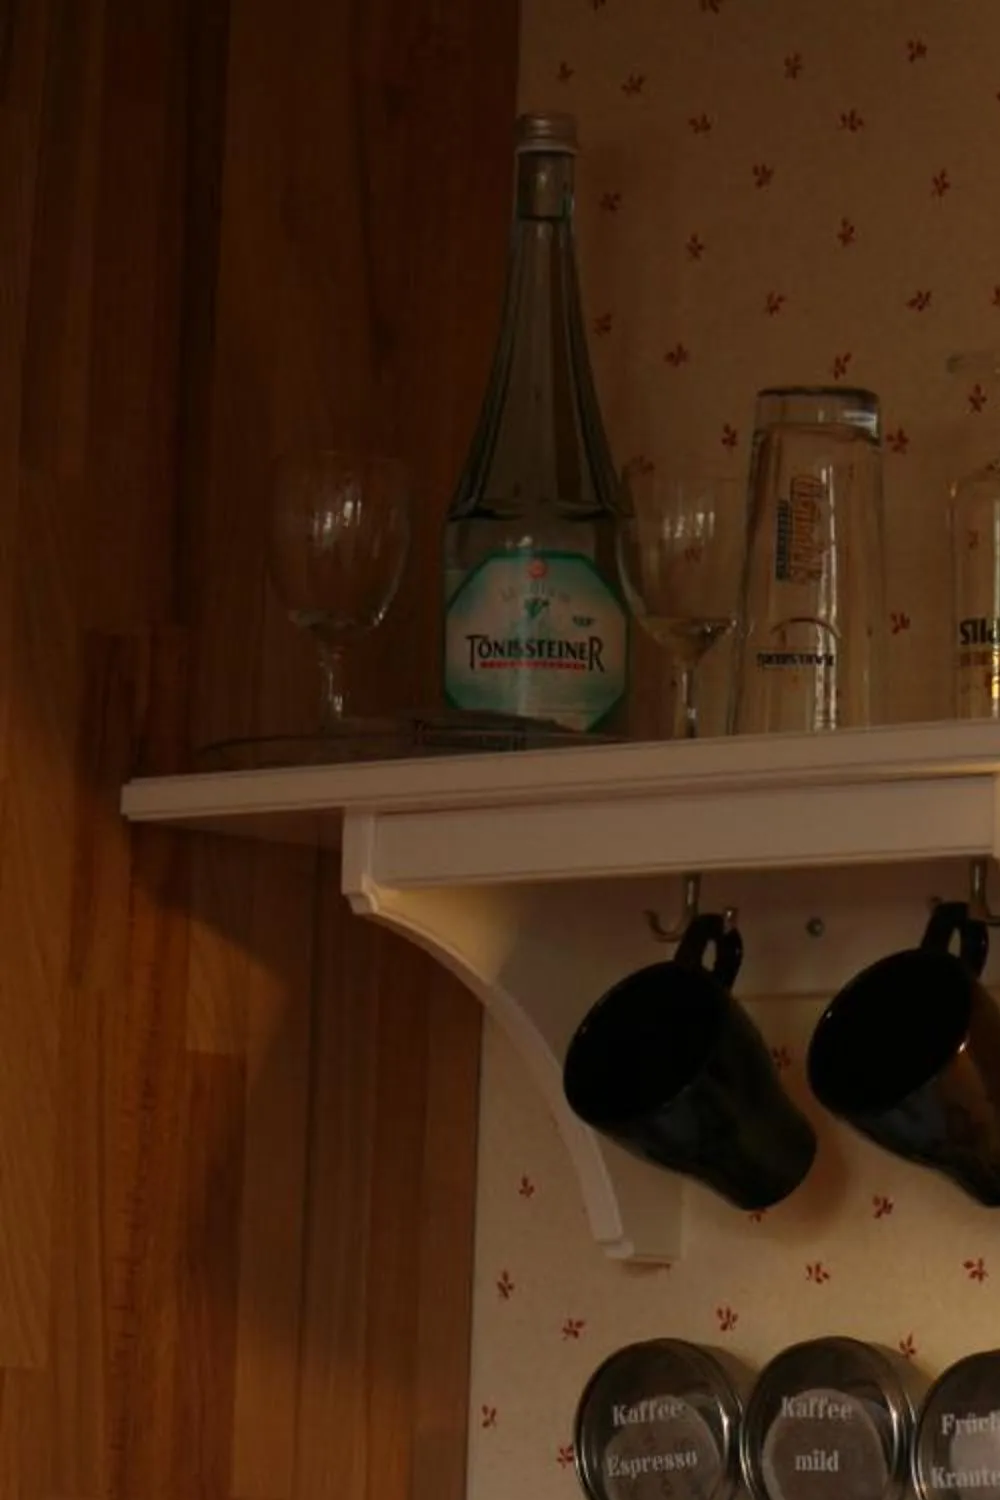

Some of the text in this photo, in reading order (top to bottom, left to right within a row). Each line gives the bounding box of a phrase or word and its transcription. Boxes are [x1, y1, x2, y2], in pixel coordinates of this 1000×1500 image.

[612, 1399, 686, 1428] Kaffee
[781, 1395, 853, 1422] Kaffee
[607, 1449, 698, 1480] Espresso
[794, 1447, 839, 1473] mild
